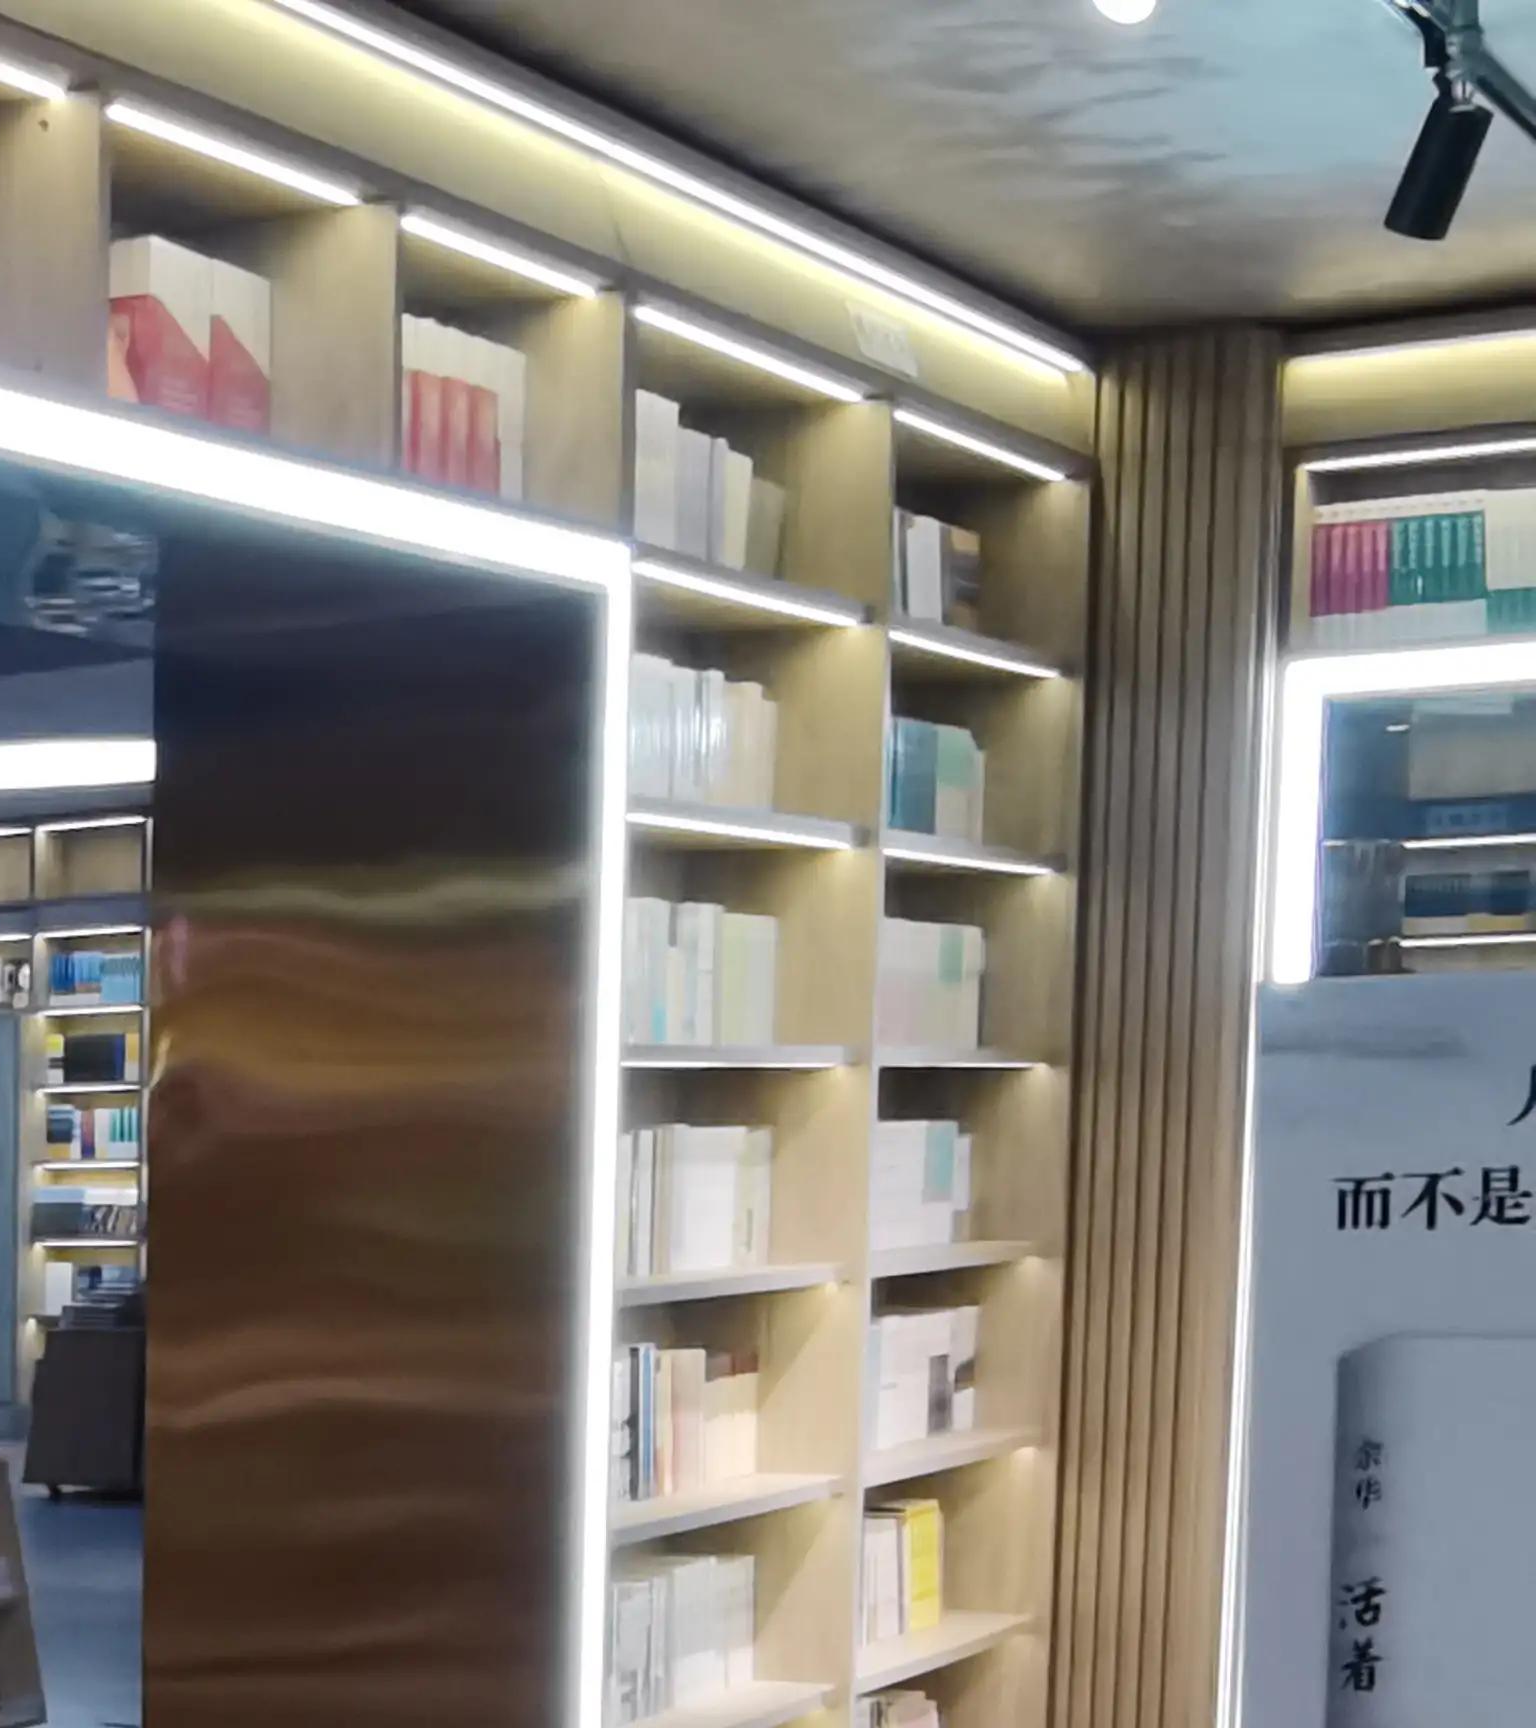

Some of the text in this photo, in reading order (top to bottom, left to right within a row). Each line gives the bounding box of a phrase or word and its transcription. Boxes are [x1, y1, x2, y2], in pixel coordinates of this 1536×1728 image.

[1331, 1164, 1534, 1231] 而不是
[1336, 1575, 1387, 1693] 活着
